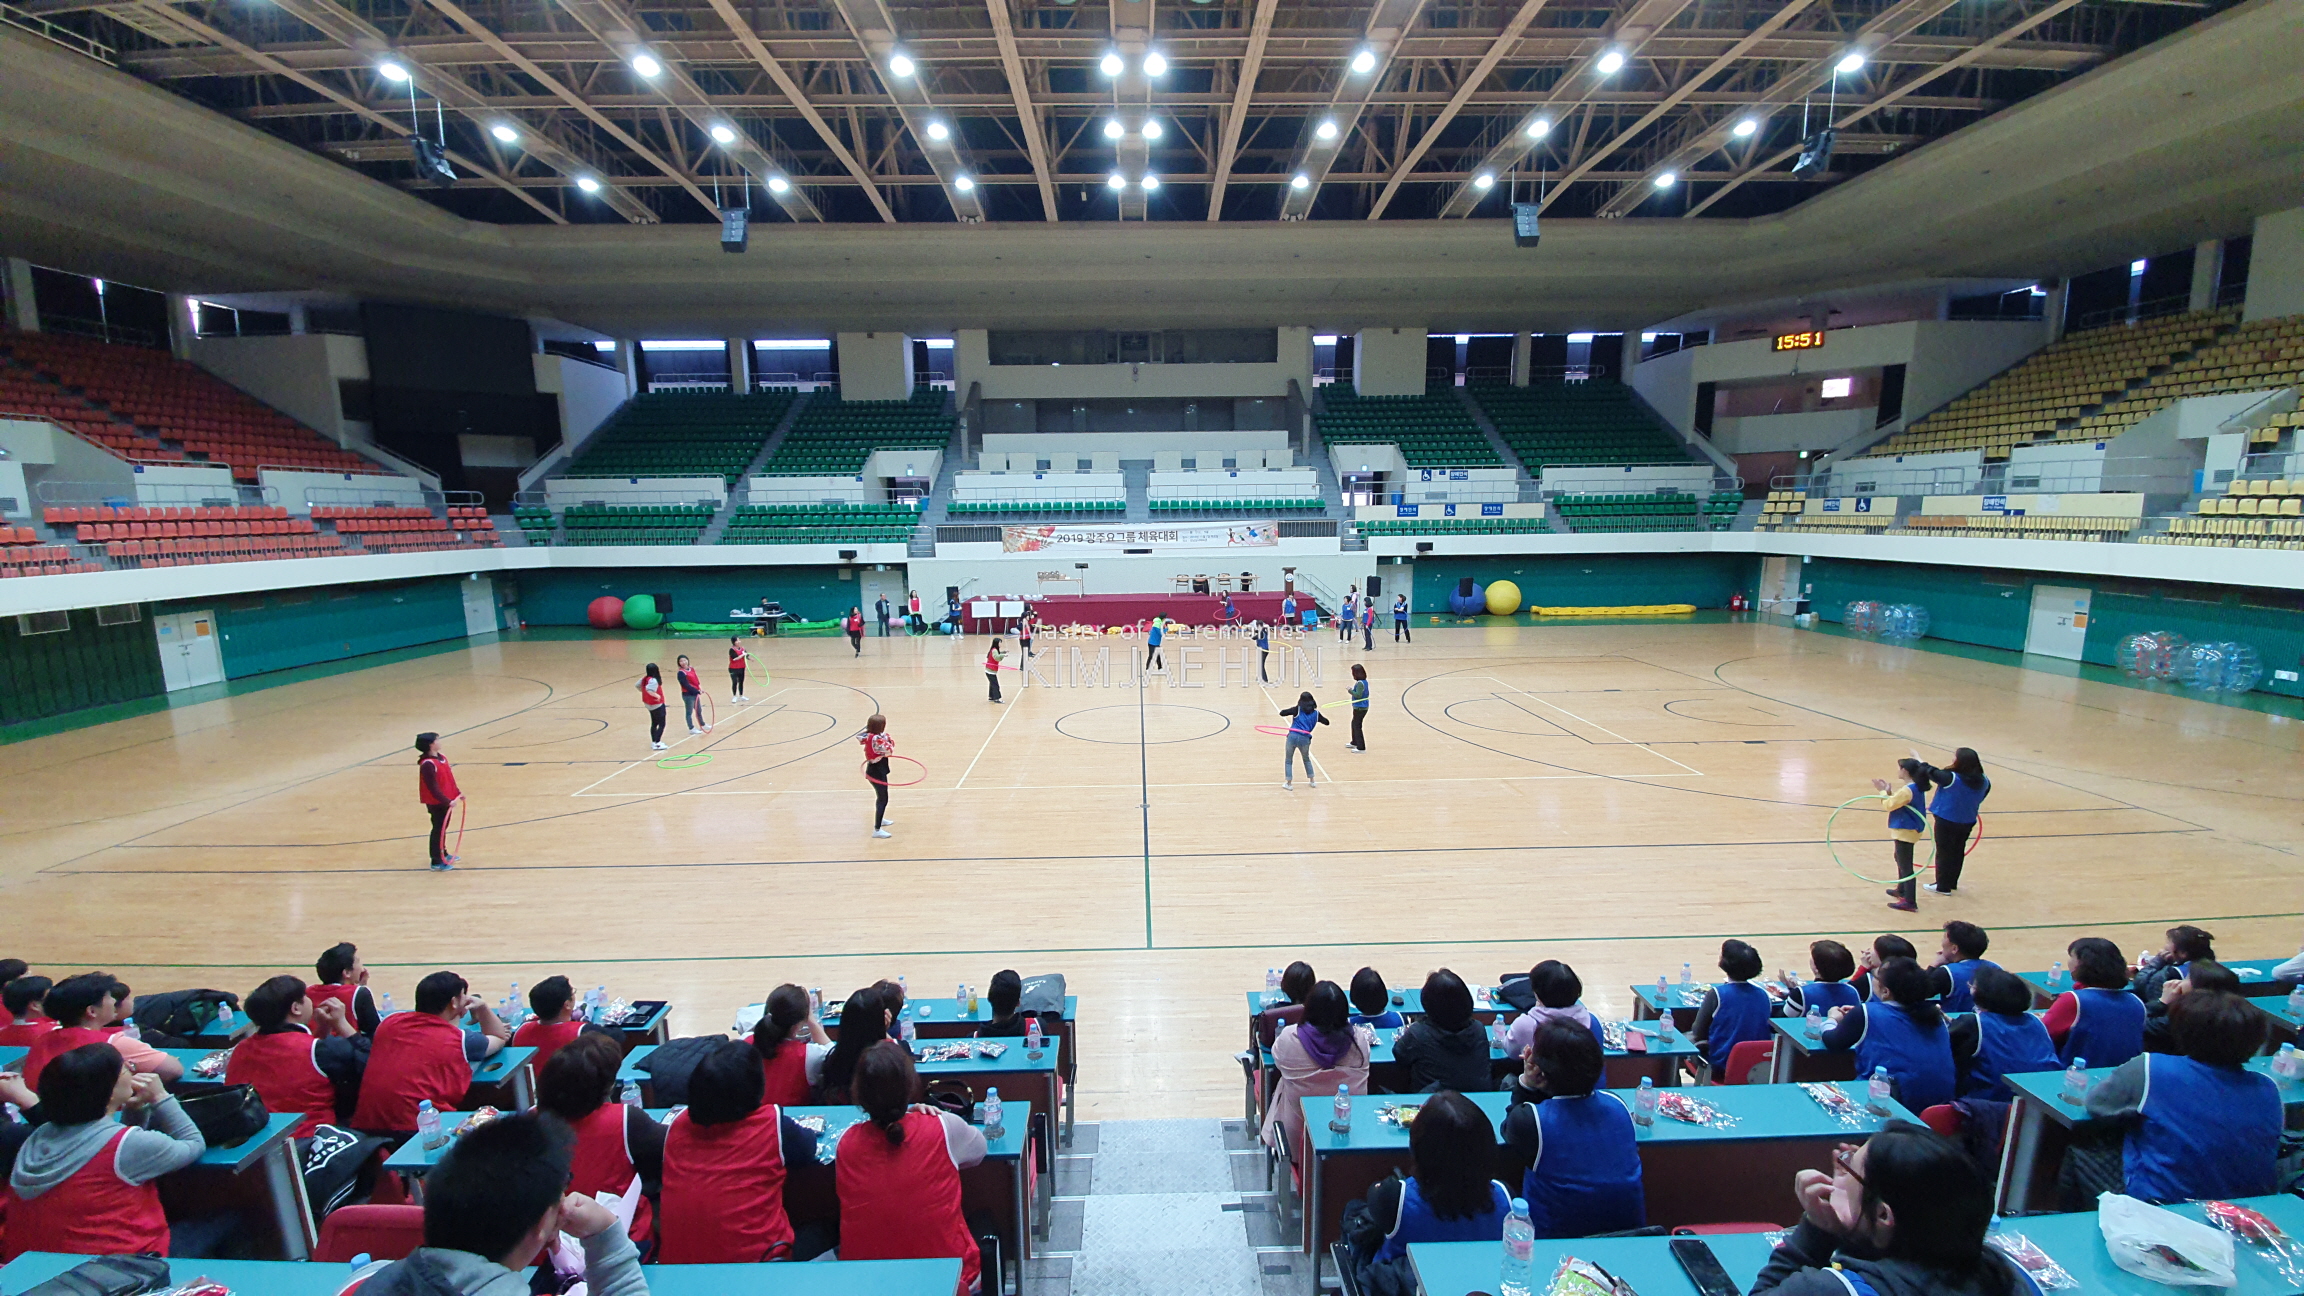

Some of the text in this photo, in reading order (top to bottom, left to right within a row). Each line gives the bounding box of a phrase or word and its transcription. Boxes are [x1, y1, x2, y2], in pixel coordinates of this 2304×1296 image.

[1776, 332, 1822, 350] 15:51
[1056, 533, 1084, 543] 2019
[1085, 531, 1137, 544] 광주요그룹
[1138, 530, 1179, 543] 체육대회
